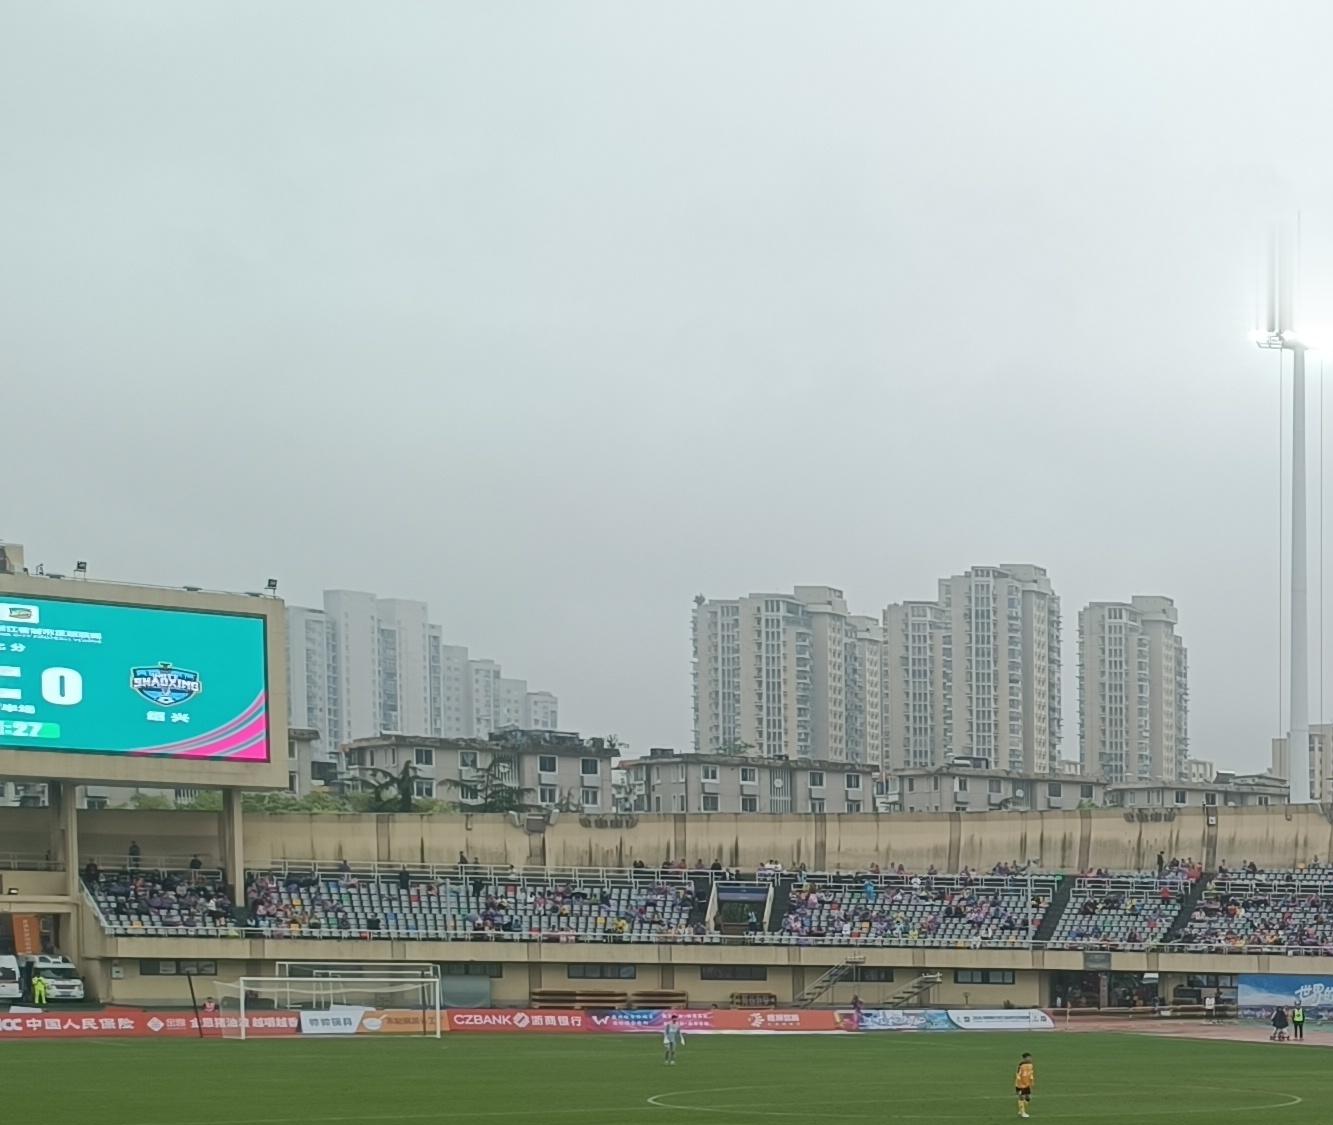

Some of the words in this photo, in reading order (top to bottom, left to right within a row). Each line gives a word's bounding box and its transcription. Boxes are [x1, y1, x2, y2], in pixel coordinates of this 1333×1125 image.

[42, 667, 82, 706] 0
[26, 1017, 135, 1031] 中国人民保险
[453, 1014, 512, 1025] CZBANK
